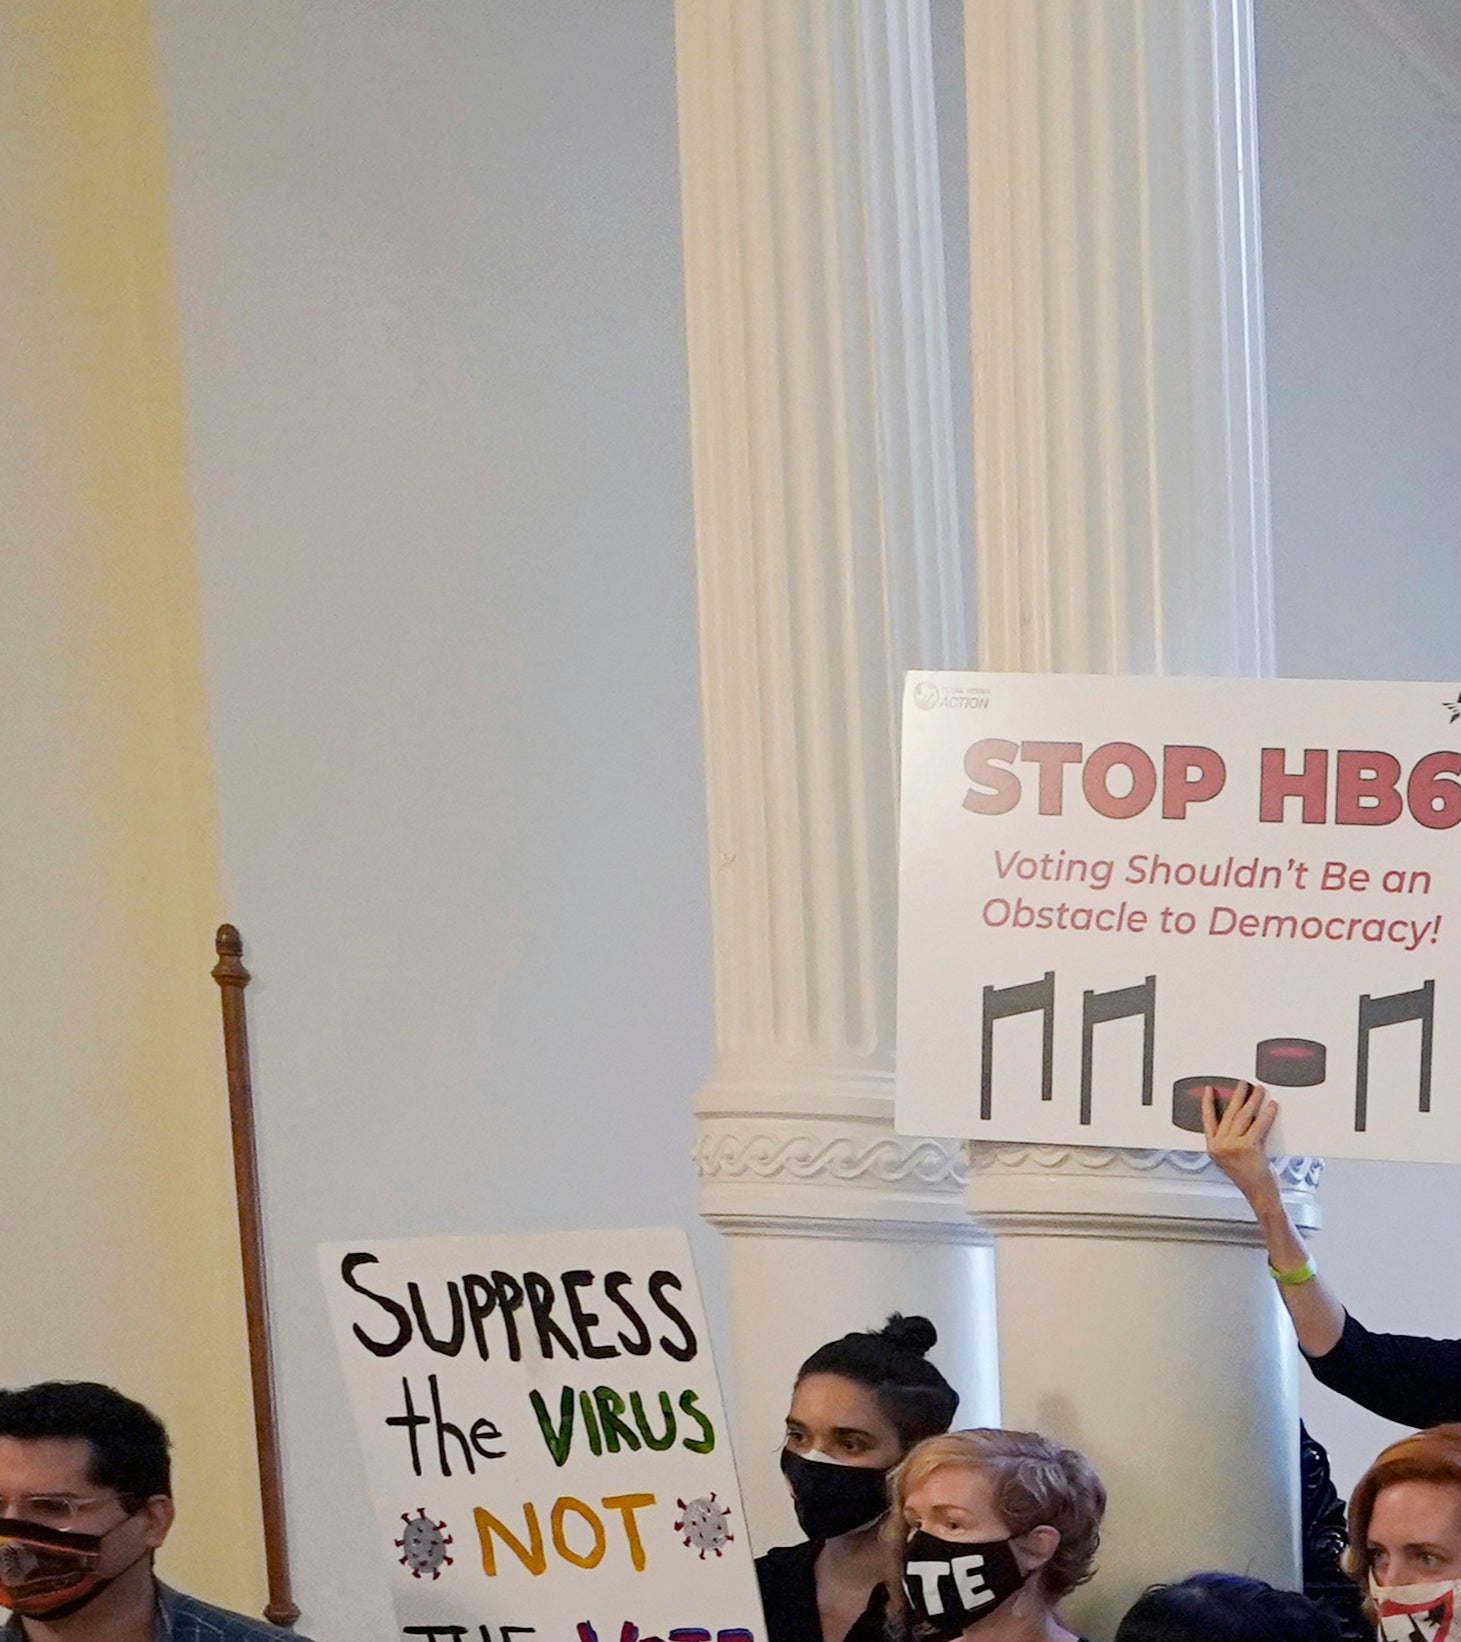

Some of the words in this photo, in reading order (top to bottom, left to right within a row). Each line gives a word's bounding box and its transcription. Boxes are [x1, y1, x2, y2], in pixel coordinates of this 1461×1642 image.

[962, 739, 1226, 819] STOP
[993, 850, 1114, 890] Voting
[1125, 854, 1308, 890] Shouldn't
[1321, 861, 1369, 892] Be
[1383, 866, 1431, 894] an
[982, 898, 1147, 933] Obstacle
[1160, 906, 1196, 934] to
[1209, 910, 1442, 951] Democracy!
[341, 1252, 697, 1361] SUPPRESS
[386, 1374, 507, 1476] the
[529, 1386, 715, 1467] VIRUS
[473, 1493, 656, 1577] NOT
